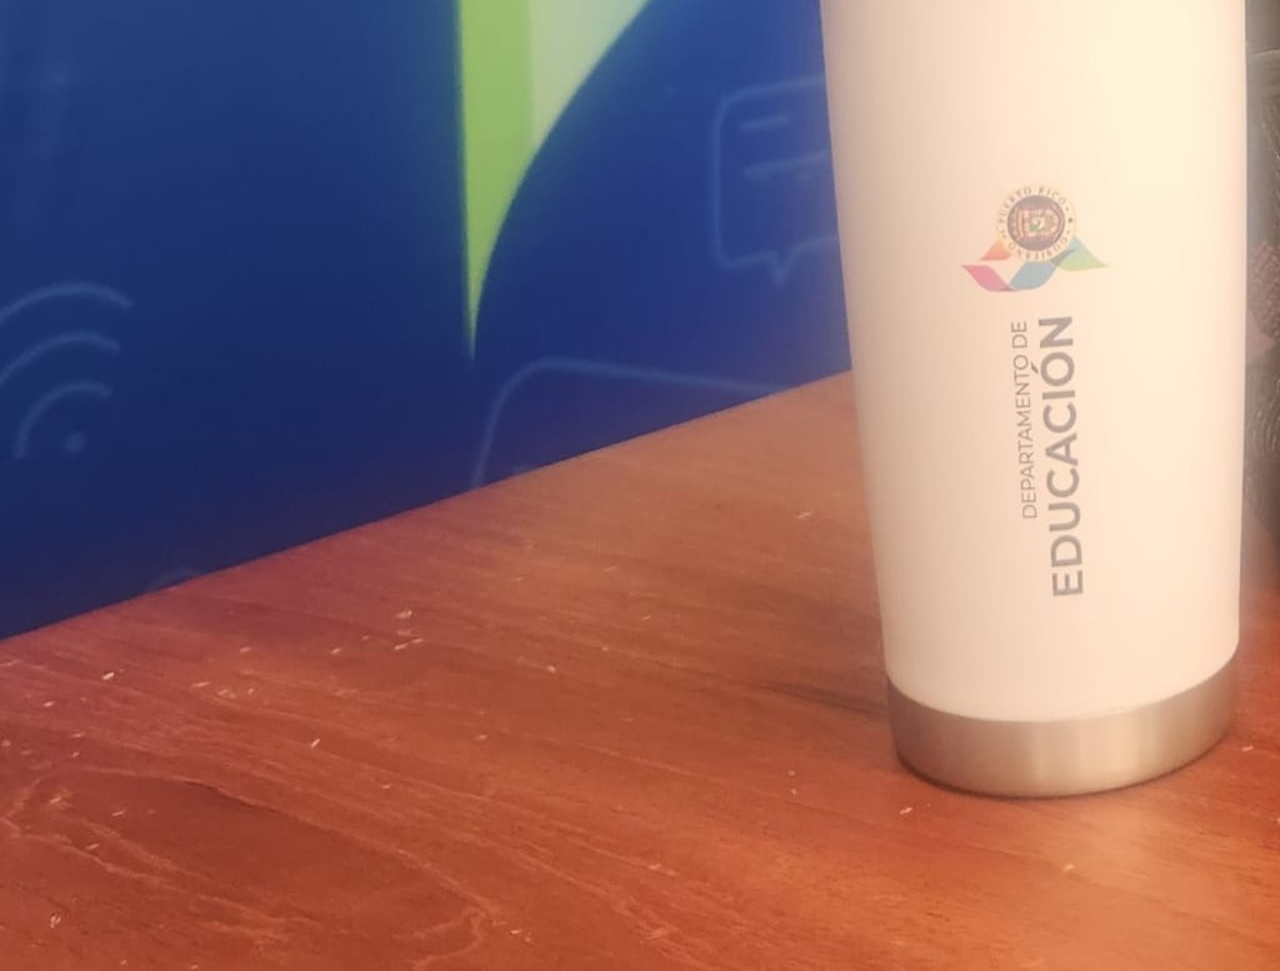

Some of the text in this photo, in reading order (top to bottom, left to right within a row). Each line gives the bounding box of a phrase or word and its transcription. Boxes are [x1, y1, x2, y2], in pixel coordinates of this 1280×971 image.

[1010, 320, 1037, 519] DEPARTAMENTO DE
[1031, 316, 1084, 597] EDUCACIÓN
